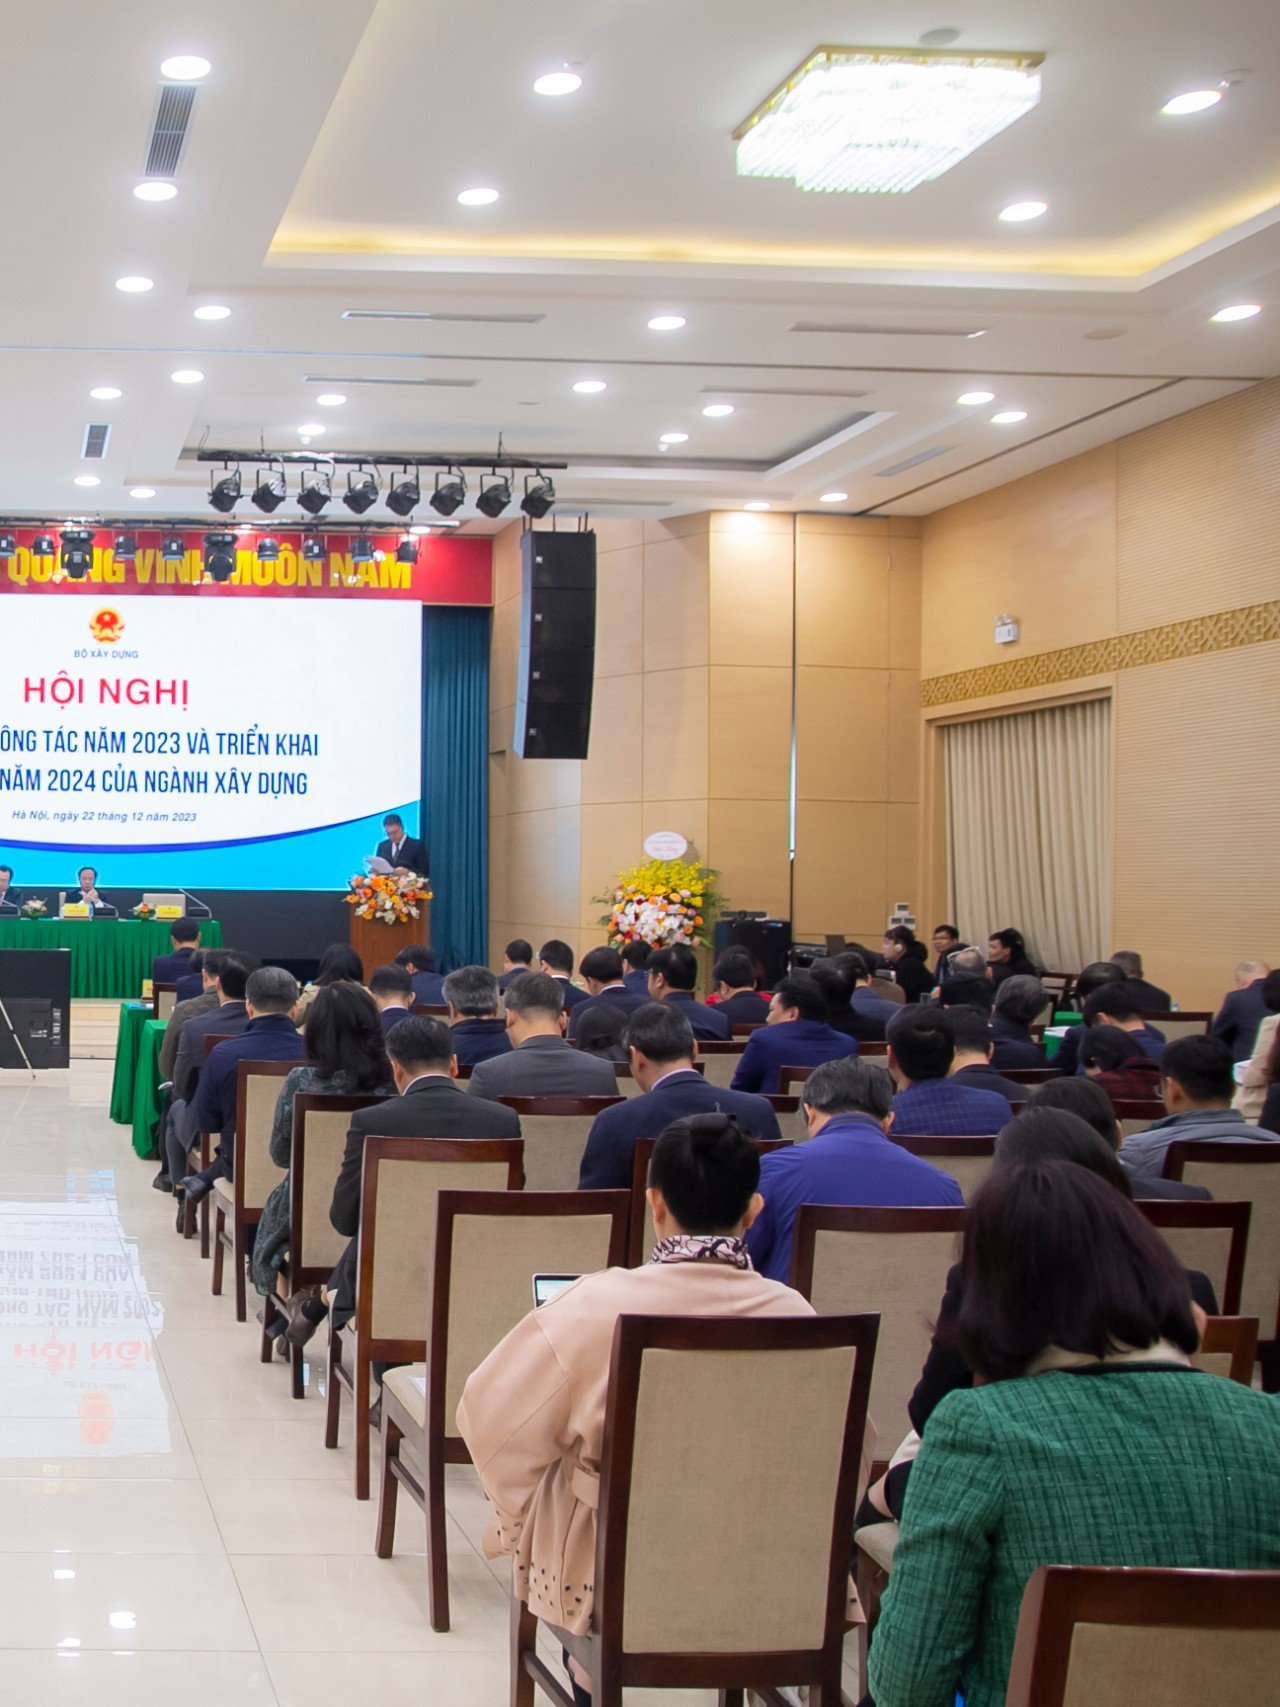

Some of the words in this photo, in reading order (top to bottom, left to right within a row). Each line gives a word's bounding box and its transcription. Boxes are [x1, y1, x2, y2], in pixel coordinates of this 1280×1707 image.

[74, 648, 88, 659] BỘ
[90, 649, 109, 658] XÂY
[24, 670, 84, 710] HỘI
[100, 678, 188, 711] NGHỊ
[43, 726, 78, 753] TÁC
[84, 726, 126, 754] NĂM
[132, 731, 181, 754] 2023
[187, 728, 210, 755] VÀ
[216, 723, 270, 756] TRIỂN
[276, 733, 318, 756] KHAI
[0, 764, 41, 791] NĂM
[47, 769, 96, 792] 2024
[102, 763, 138, 793] CỦA
[144, 766, 209, 793] NGÀNH
[215, 767, 252, 794] XÂY
[258, 771, 308, 799] DỰNG
[12, 810, 26, 820] Hà
[53, 812, 79, 823] ngày
[82, 811, 95, 821] 22
[98, 812, 128, 823] tháng
[132, 812, 144, 821] 12
[172, 812, 197, 822] 2023
